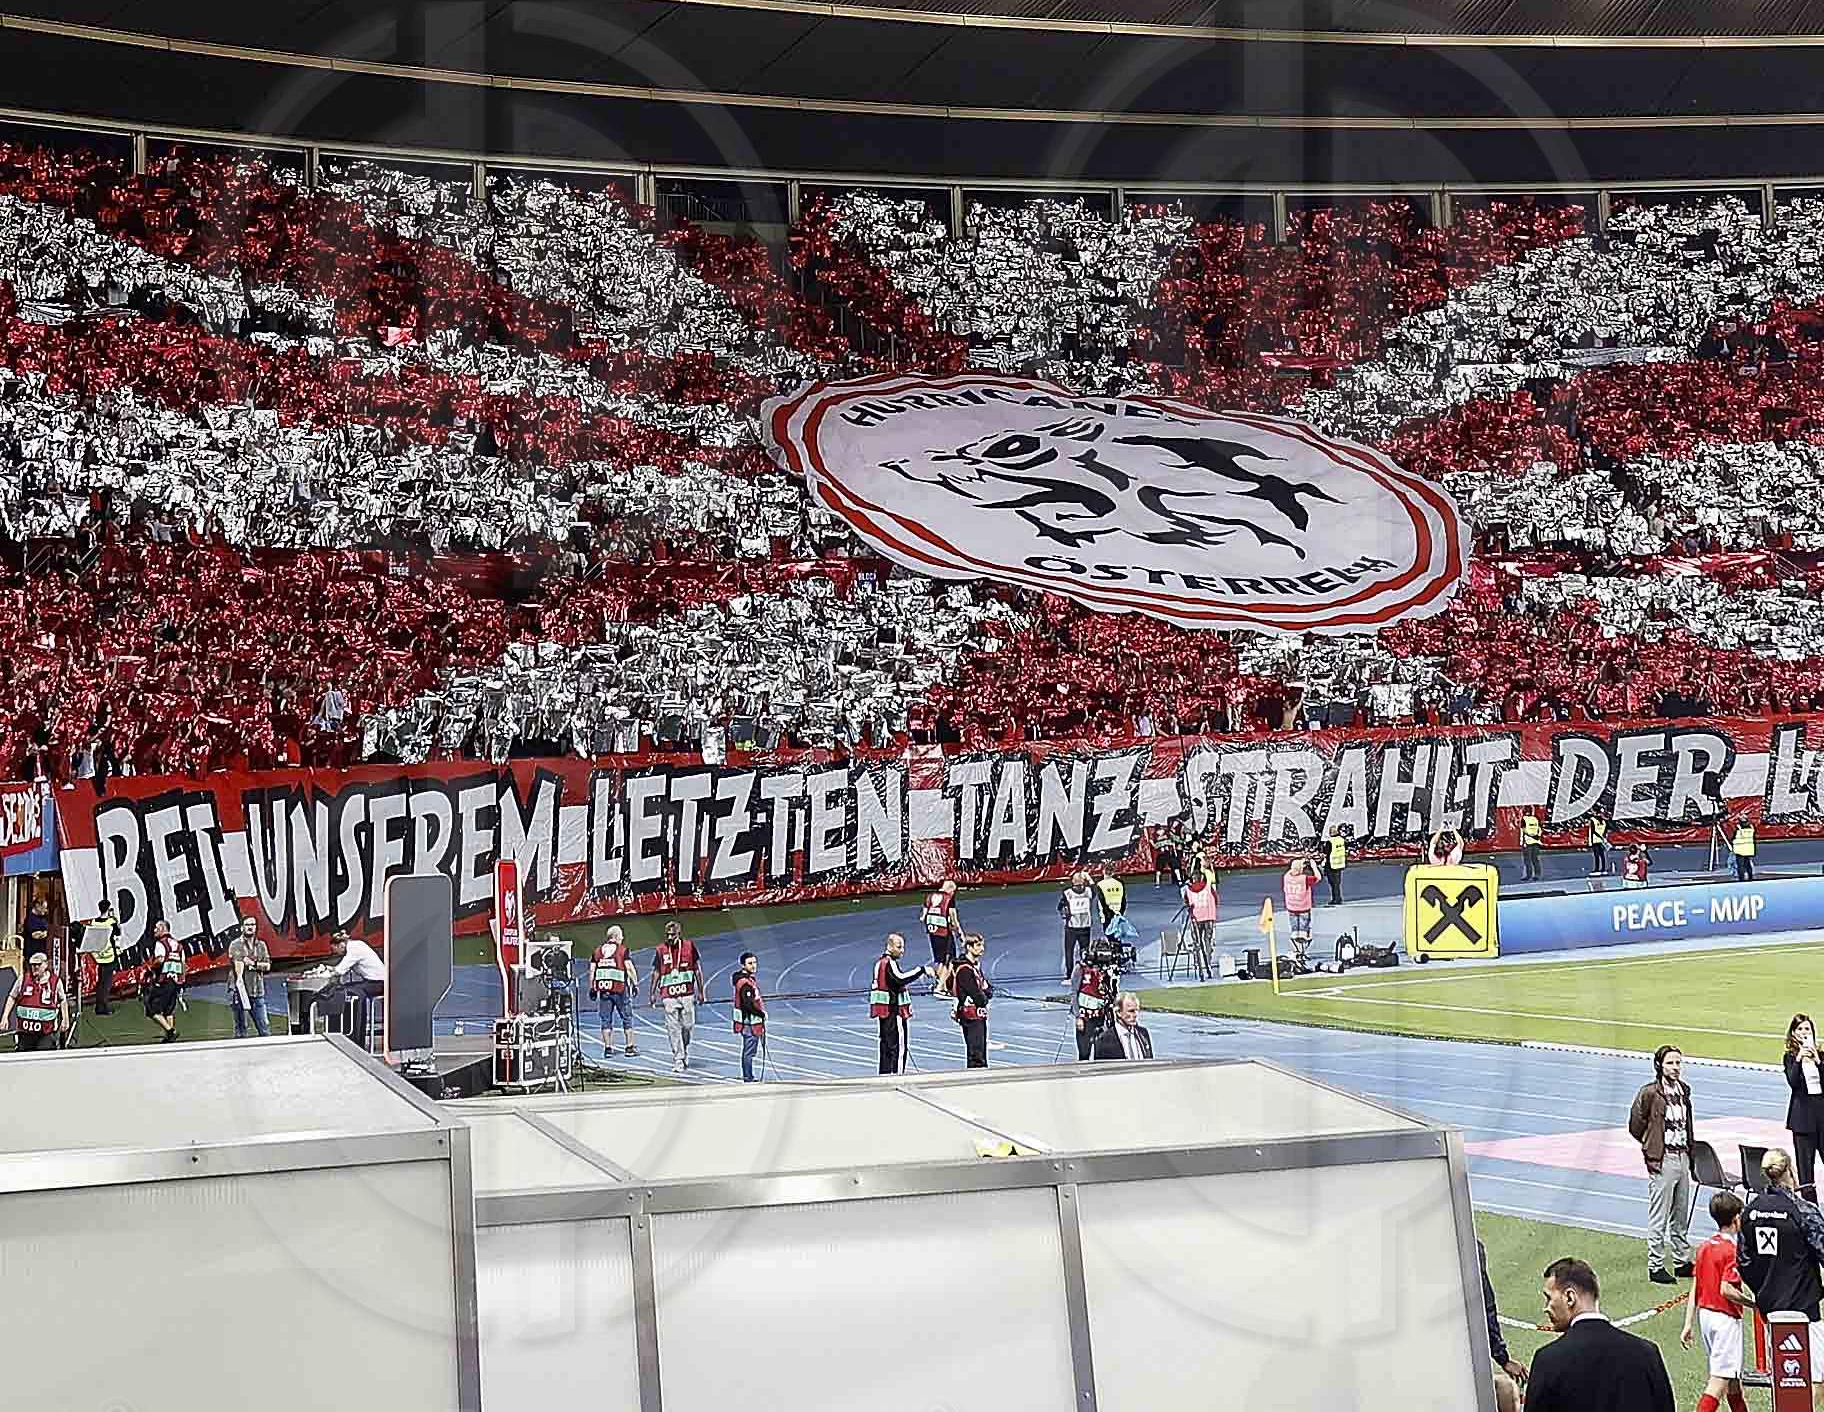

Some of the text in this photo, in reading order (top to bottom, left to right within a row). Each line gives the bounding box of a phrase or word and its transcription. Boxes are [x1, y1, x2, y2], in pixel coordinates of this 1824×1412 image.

[96, 791, 239, 950] BEI
[247, 780, 556, 927] UNSEREM
[590, 769, 903, 889] LETZTEN
[948, 755, 1147, 862] TANZ
[1182, 739, 1515, 844] STRAHLT
[1549, 731, 1728, 824] DER
[1613, 904, 1688, 932] PEACE
[1710, 894, 1765, 923] МИР
